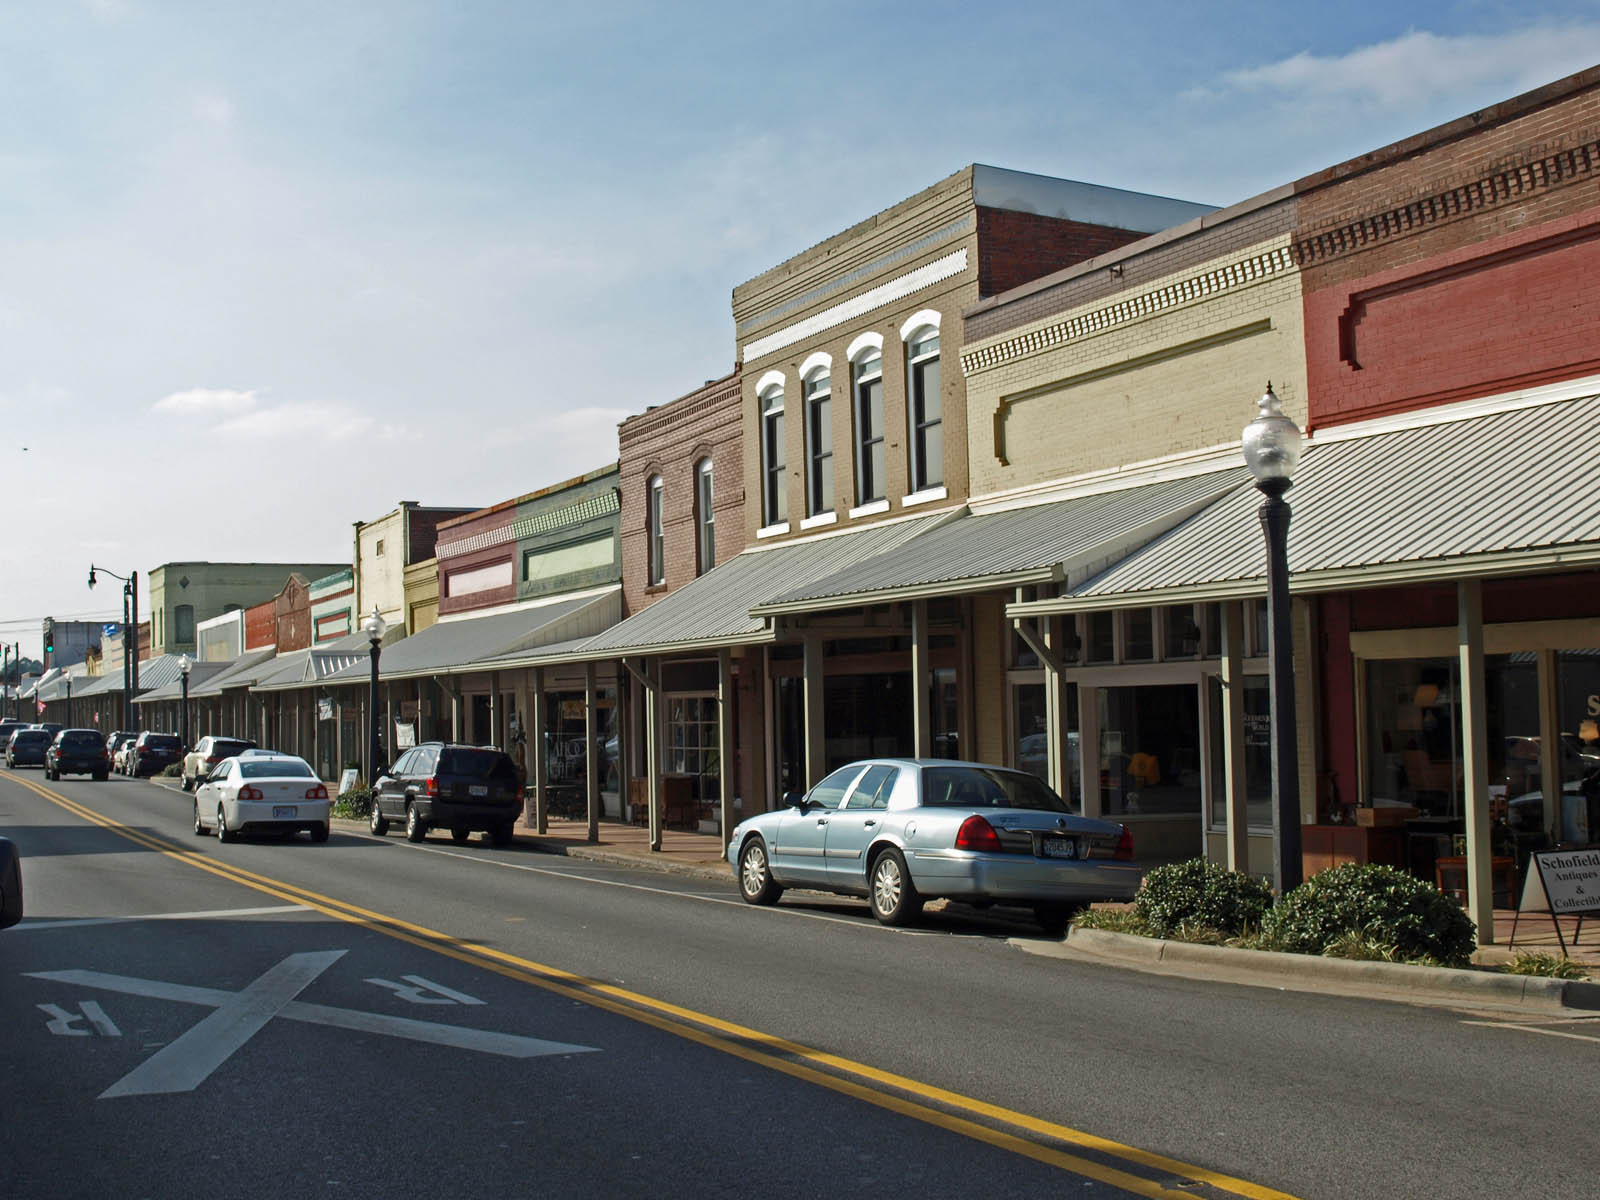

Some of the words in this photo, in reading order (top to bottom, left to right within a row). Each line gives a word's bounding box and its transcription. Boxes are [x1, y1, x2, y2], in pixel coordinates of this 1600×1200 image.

[1555, 871, 1598, 882] Antiques
[1576, 885, 1585, 895] &
[1554, 896, 1600, 908] Collectib
